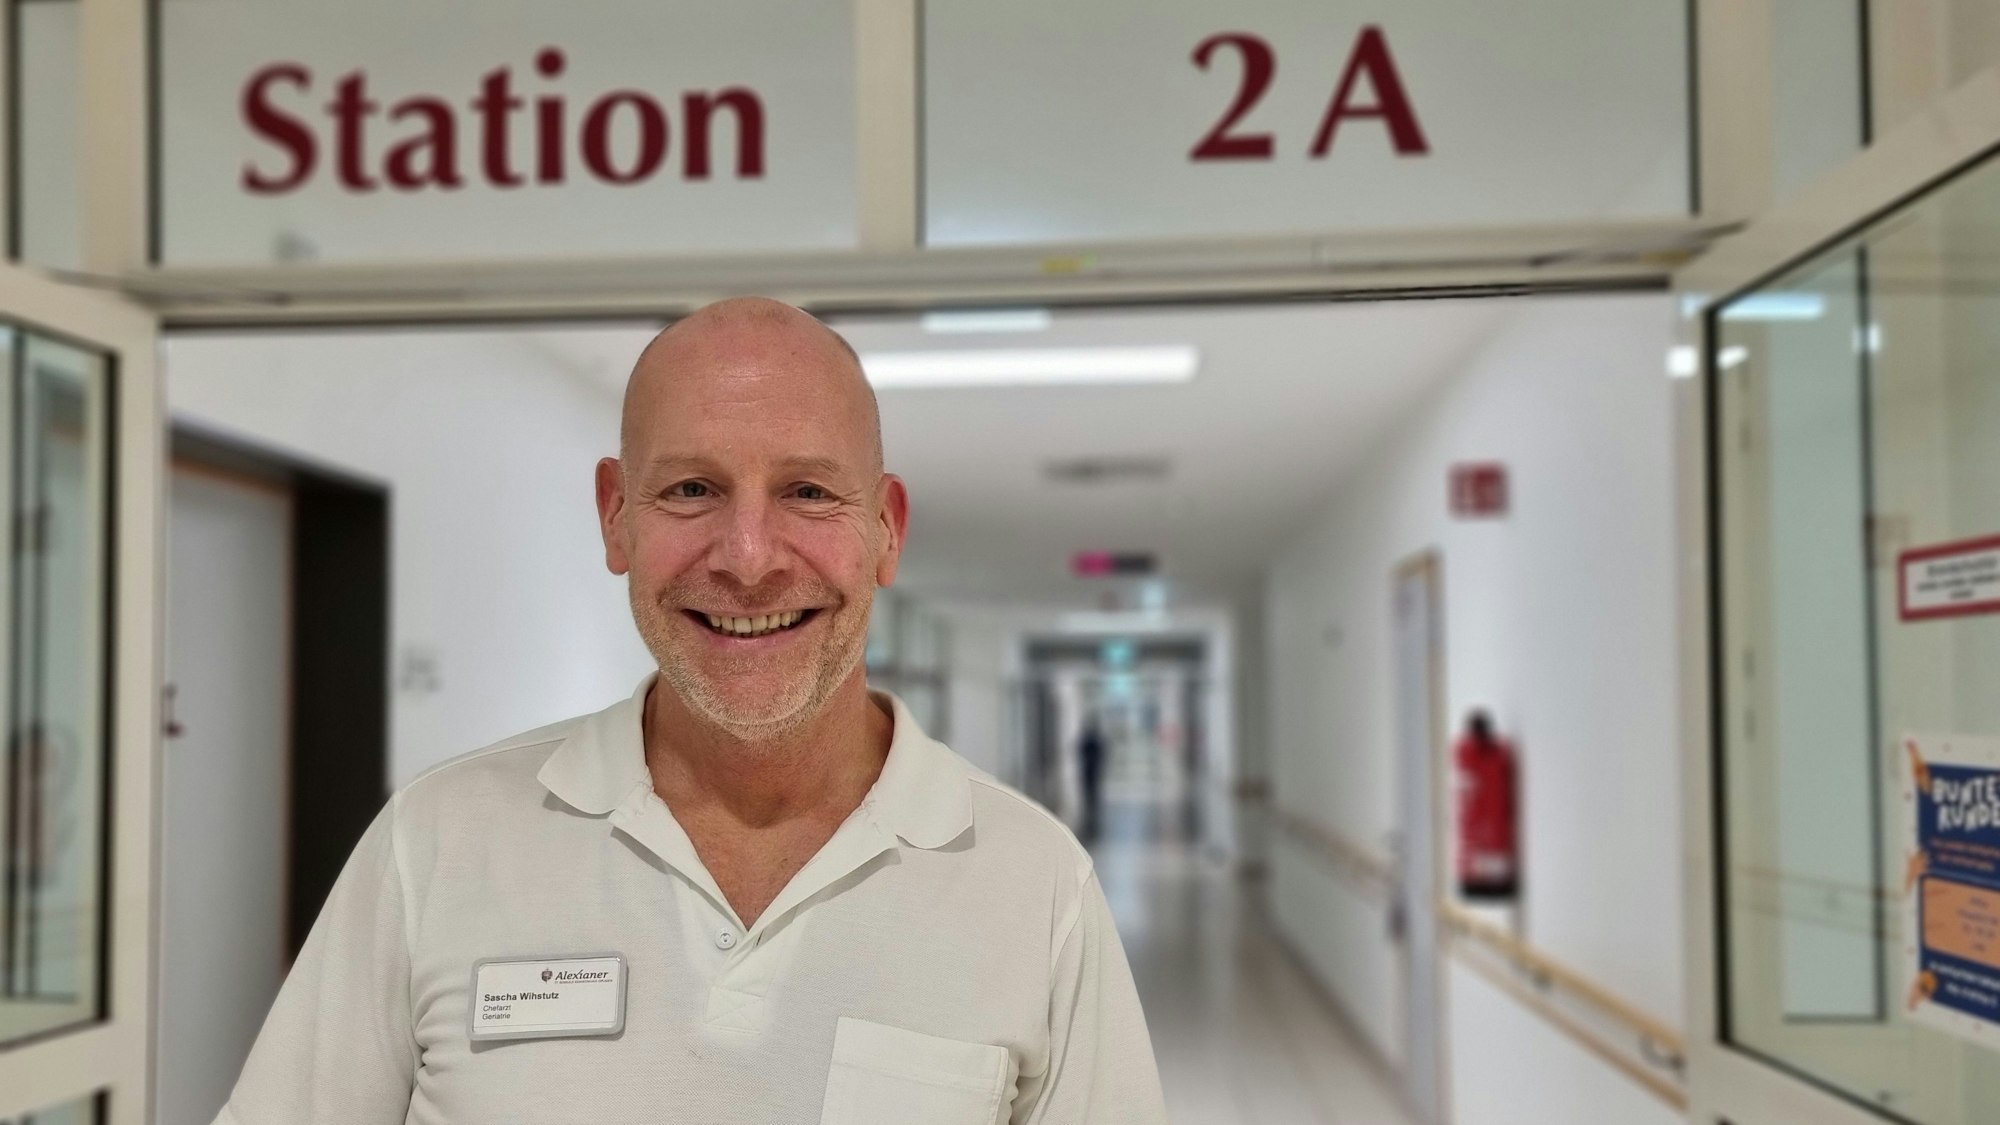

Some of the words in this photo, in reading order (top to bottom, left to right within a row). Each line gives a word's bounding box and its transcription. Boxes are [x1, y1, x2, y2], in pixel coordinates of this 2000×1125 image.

[240, 49, 766, 196] Station
[1190, 32, 1277, 161] 2
[1309, 25, 1431, 159] A
[555, 969, 608, 981] Alexianer
[484, 993, 517, 1002] Sascha
[520, 991, 559, 1001] Wihstutz
[483, 1004, 511, 1012] Chefarzt
